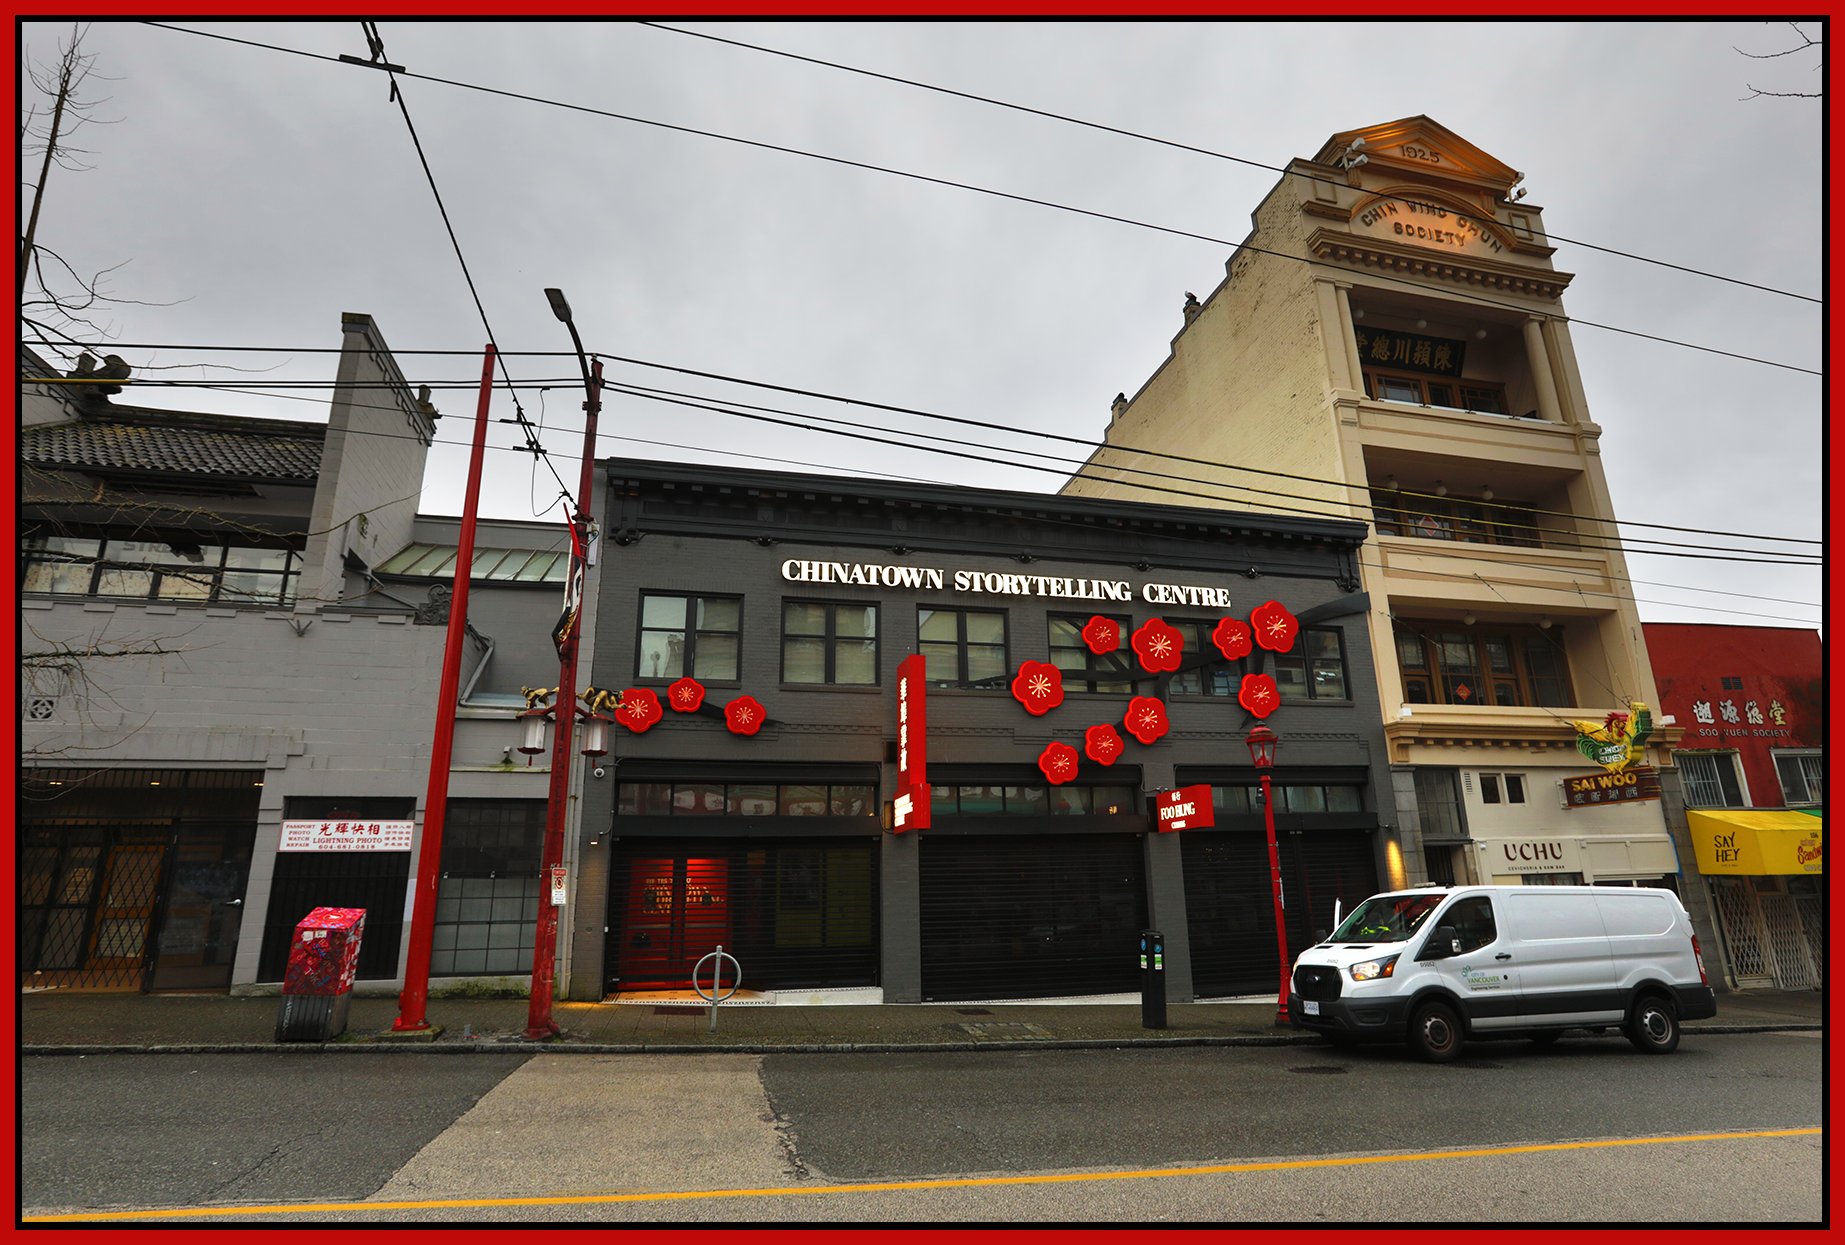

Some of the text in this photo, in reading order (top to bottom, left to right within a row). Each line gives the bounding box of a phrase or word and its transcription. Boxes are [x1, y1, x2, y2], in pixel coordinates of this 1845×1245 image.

[1401, 145, 1440, 163] 1925
[1360, 201, 1503, 253] CHIN WING CHUN
[1393, 221, 1466, 247] SOCIETY
[781, 558, 1232, 608] CHINATOWN STORYTELLING CENTRE
[1699, 728, 1791, 737] SOO YUEN SOCIETY
[1571, 772, 1637, 792] SAI WOO
[1160, 802, 1196, 821] FOO HUNG
[318, 822, 381, 836] 光輝快相
[1714, 831, 1736, 848] SAY
[1503, 843, 1563, 861] UCHU
[1715, 848, 1741, 862] HEY
